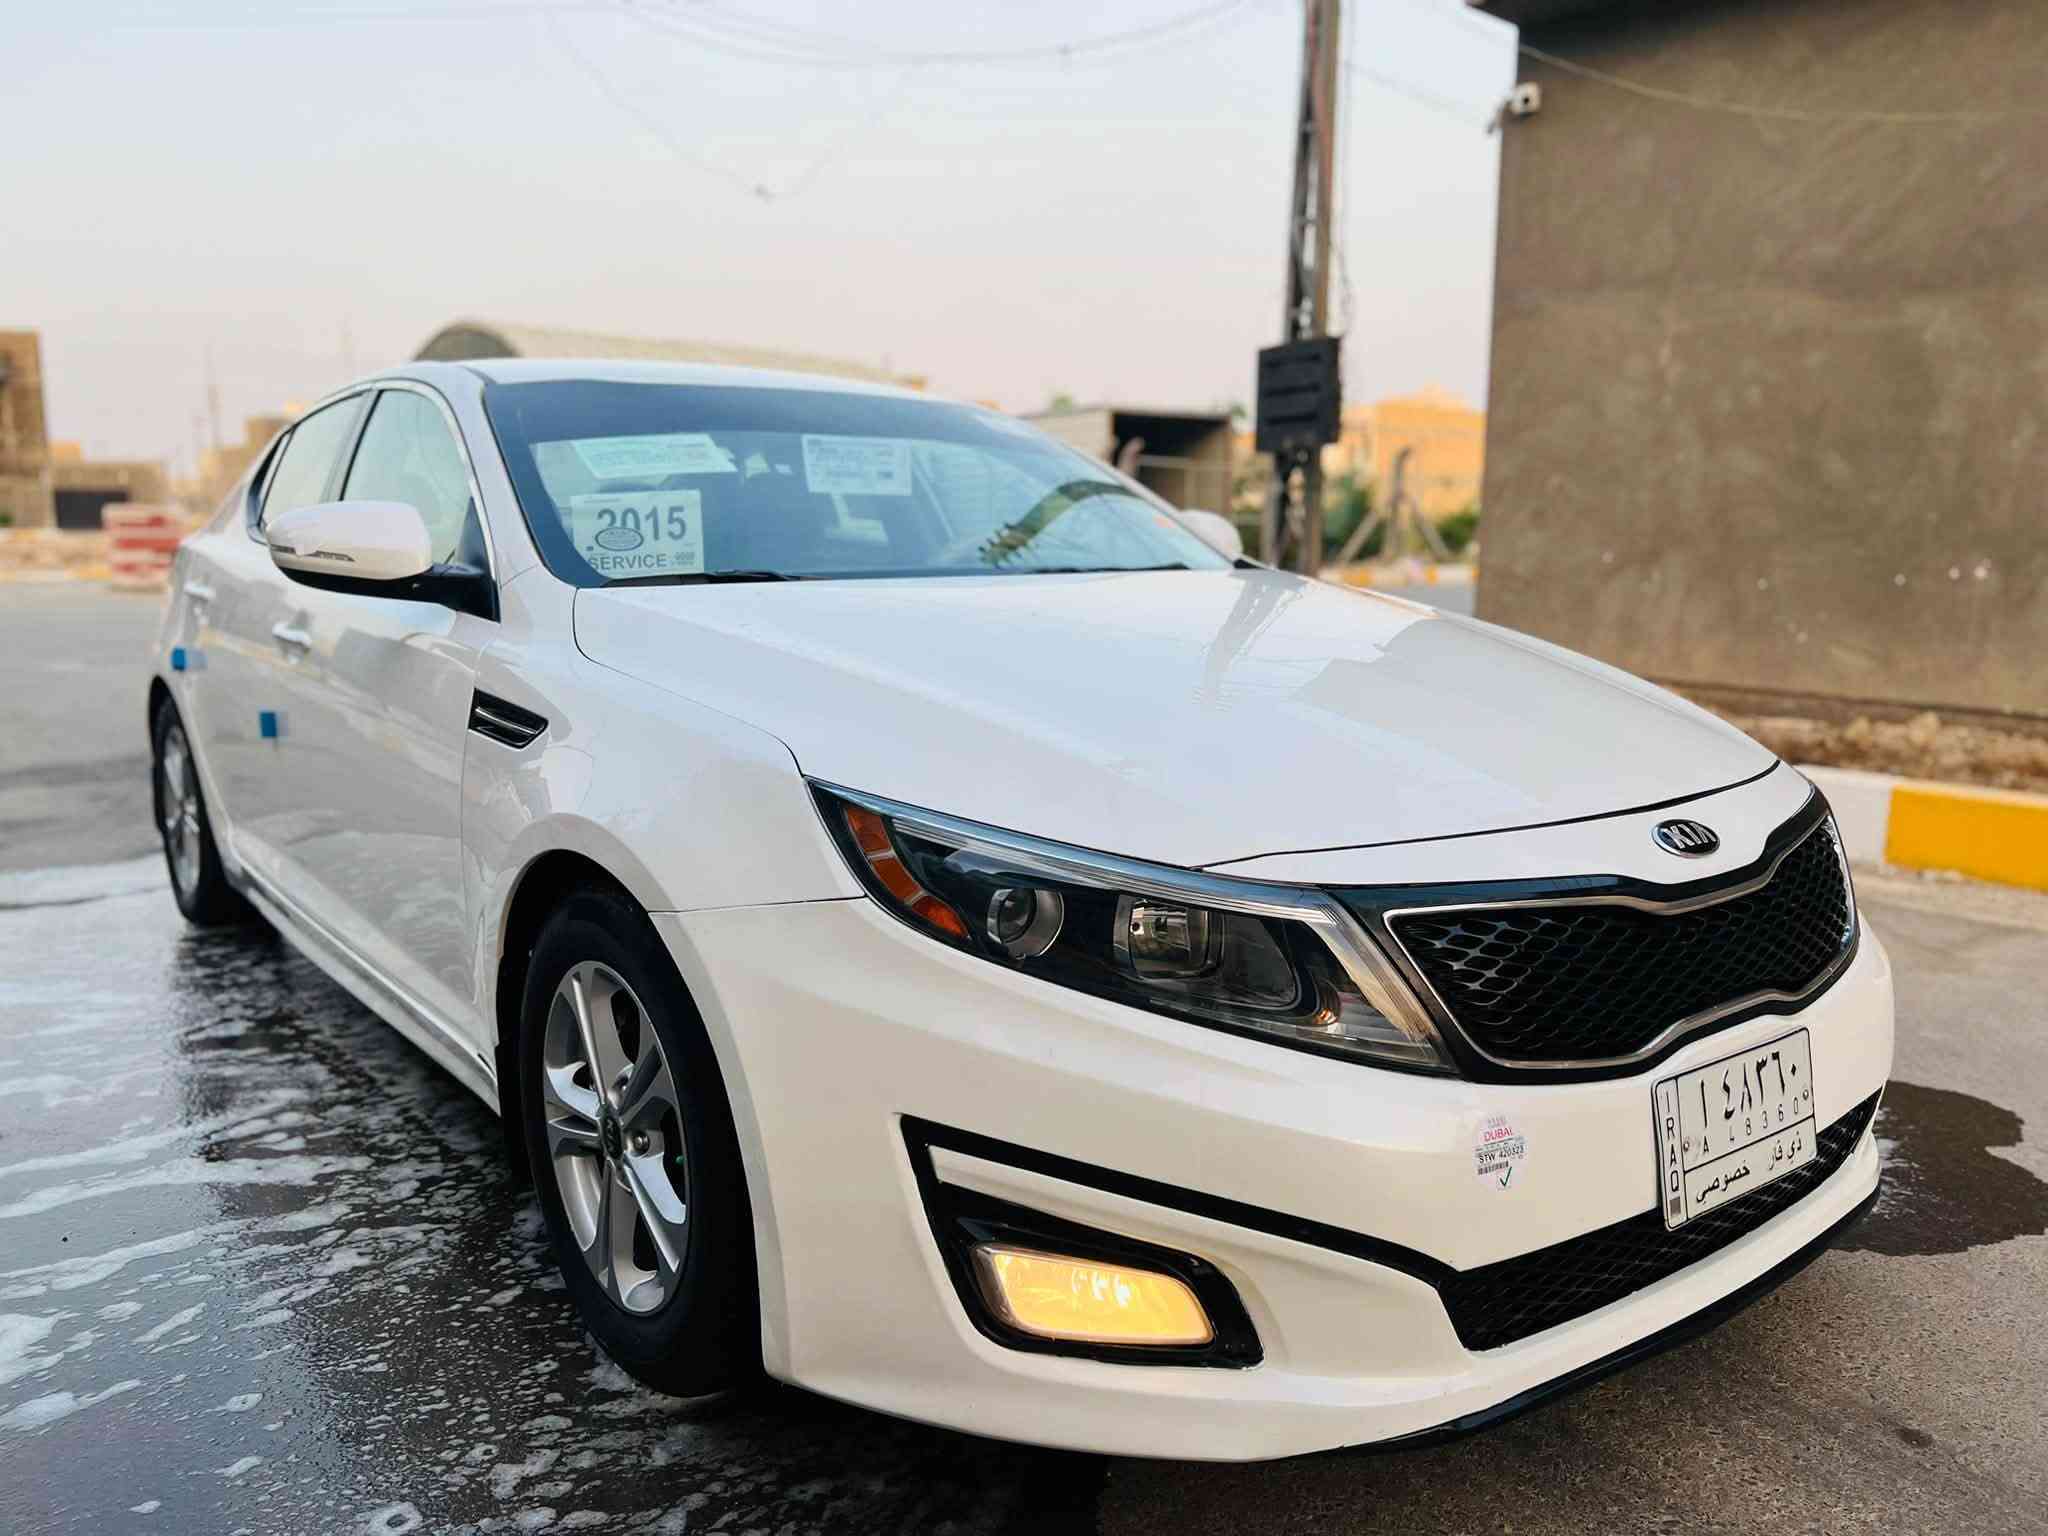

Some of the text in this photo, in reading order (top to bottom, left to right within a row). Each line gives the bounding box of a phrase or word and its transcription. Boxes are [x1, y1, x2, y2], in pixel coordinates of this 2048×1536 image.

[597, 505, 687, 541] 2015
[588, 553, 668, 571] SERVICE
[1484, 1127, 1513, 1142] DUBAI
[1665, 1090, 1681, 1193] IRAQ
